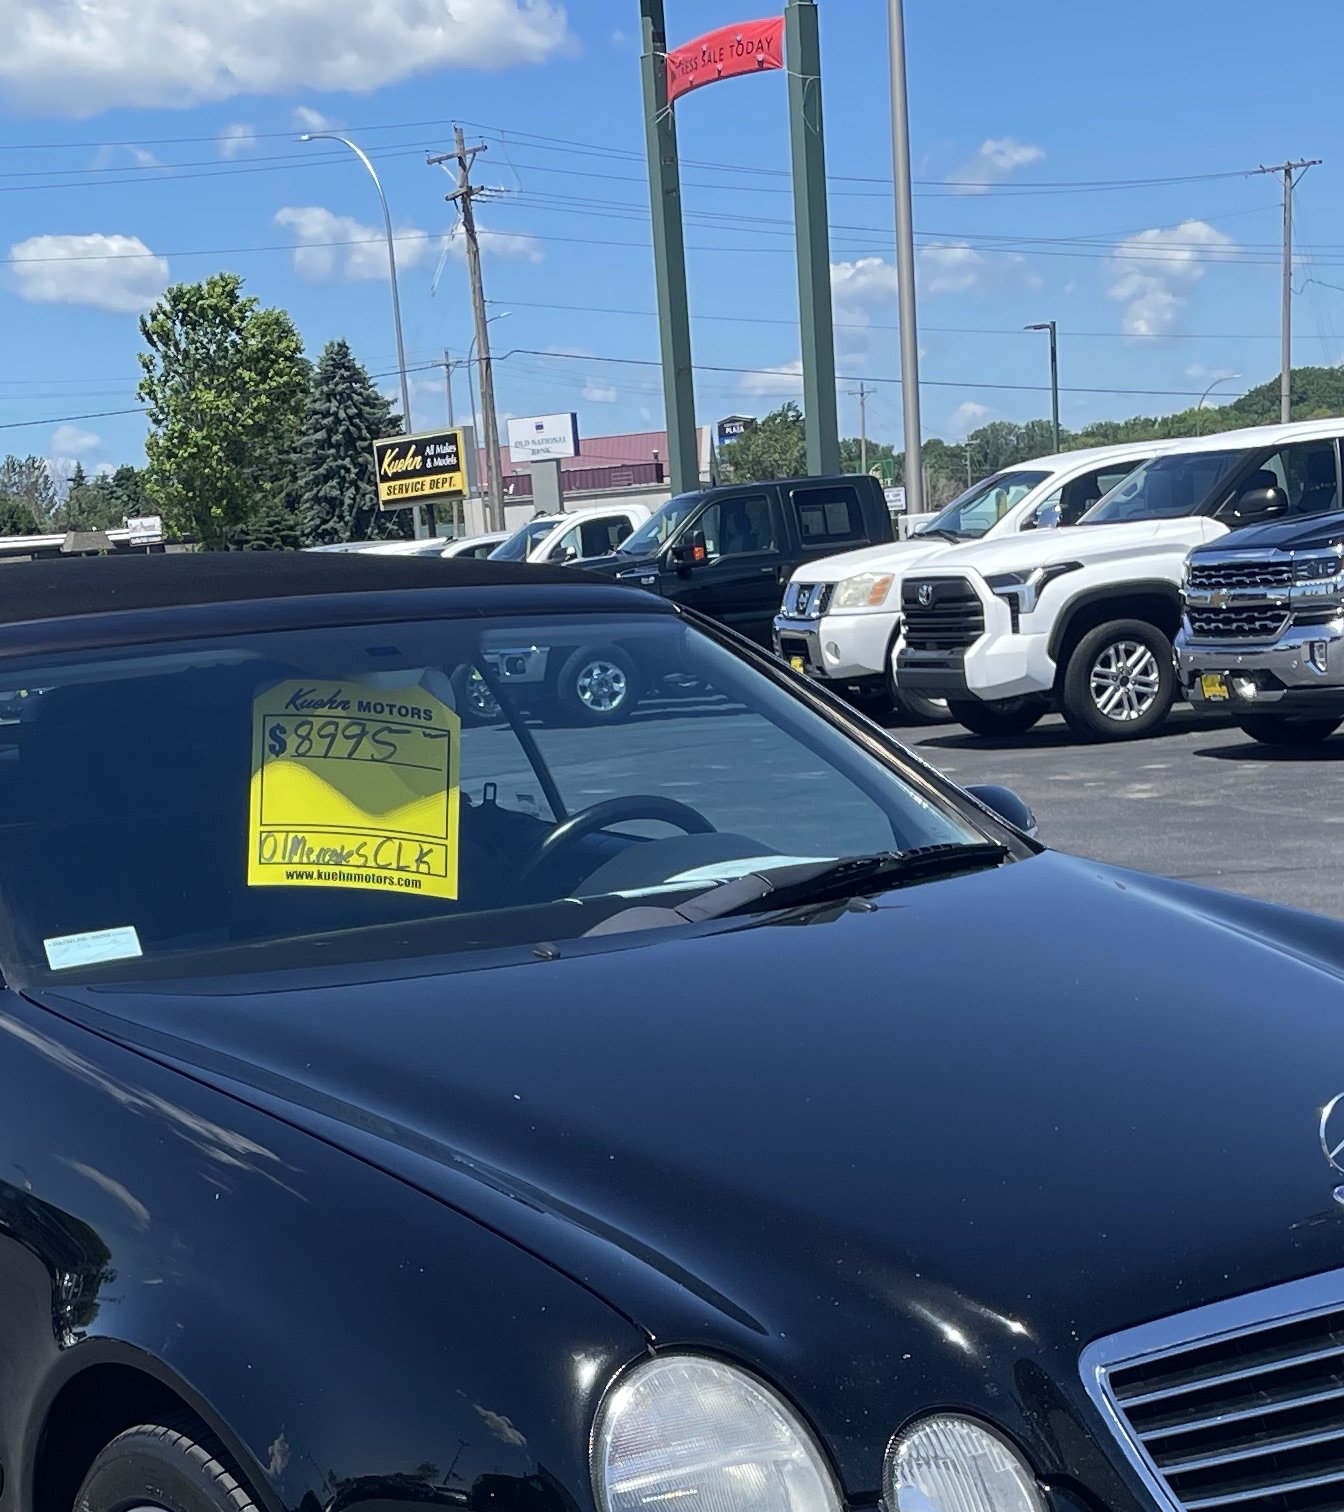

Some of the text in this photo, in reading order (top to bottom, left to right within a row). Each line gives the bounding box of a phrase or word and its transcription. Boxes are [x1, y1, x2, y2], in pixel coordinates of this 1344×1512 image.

[701, 48, 724, 68] SALE
[729, 37, 773, 58] TODAY
[381, 444, 423, 477] Kuehn
[424, 442, 456, 456] All Makes
[425, 454, 457, 468] & Models
[386, 476, 456, 496] SERVICE DEPT.
[285, 688, 433, 721] Kuehn MOTORS
[373, 837, 433, 874] CLK
[286, 870, 421, 889] www.kuehnmotors.com
